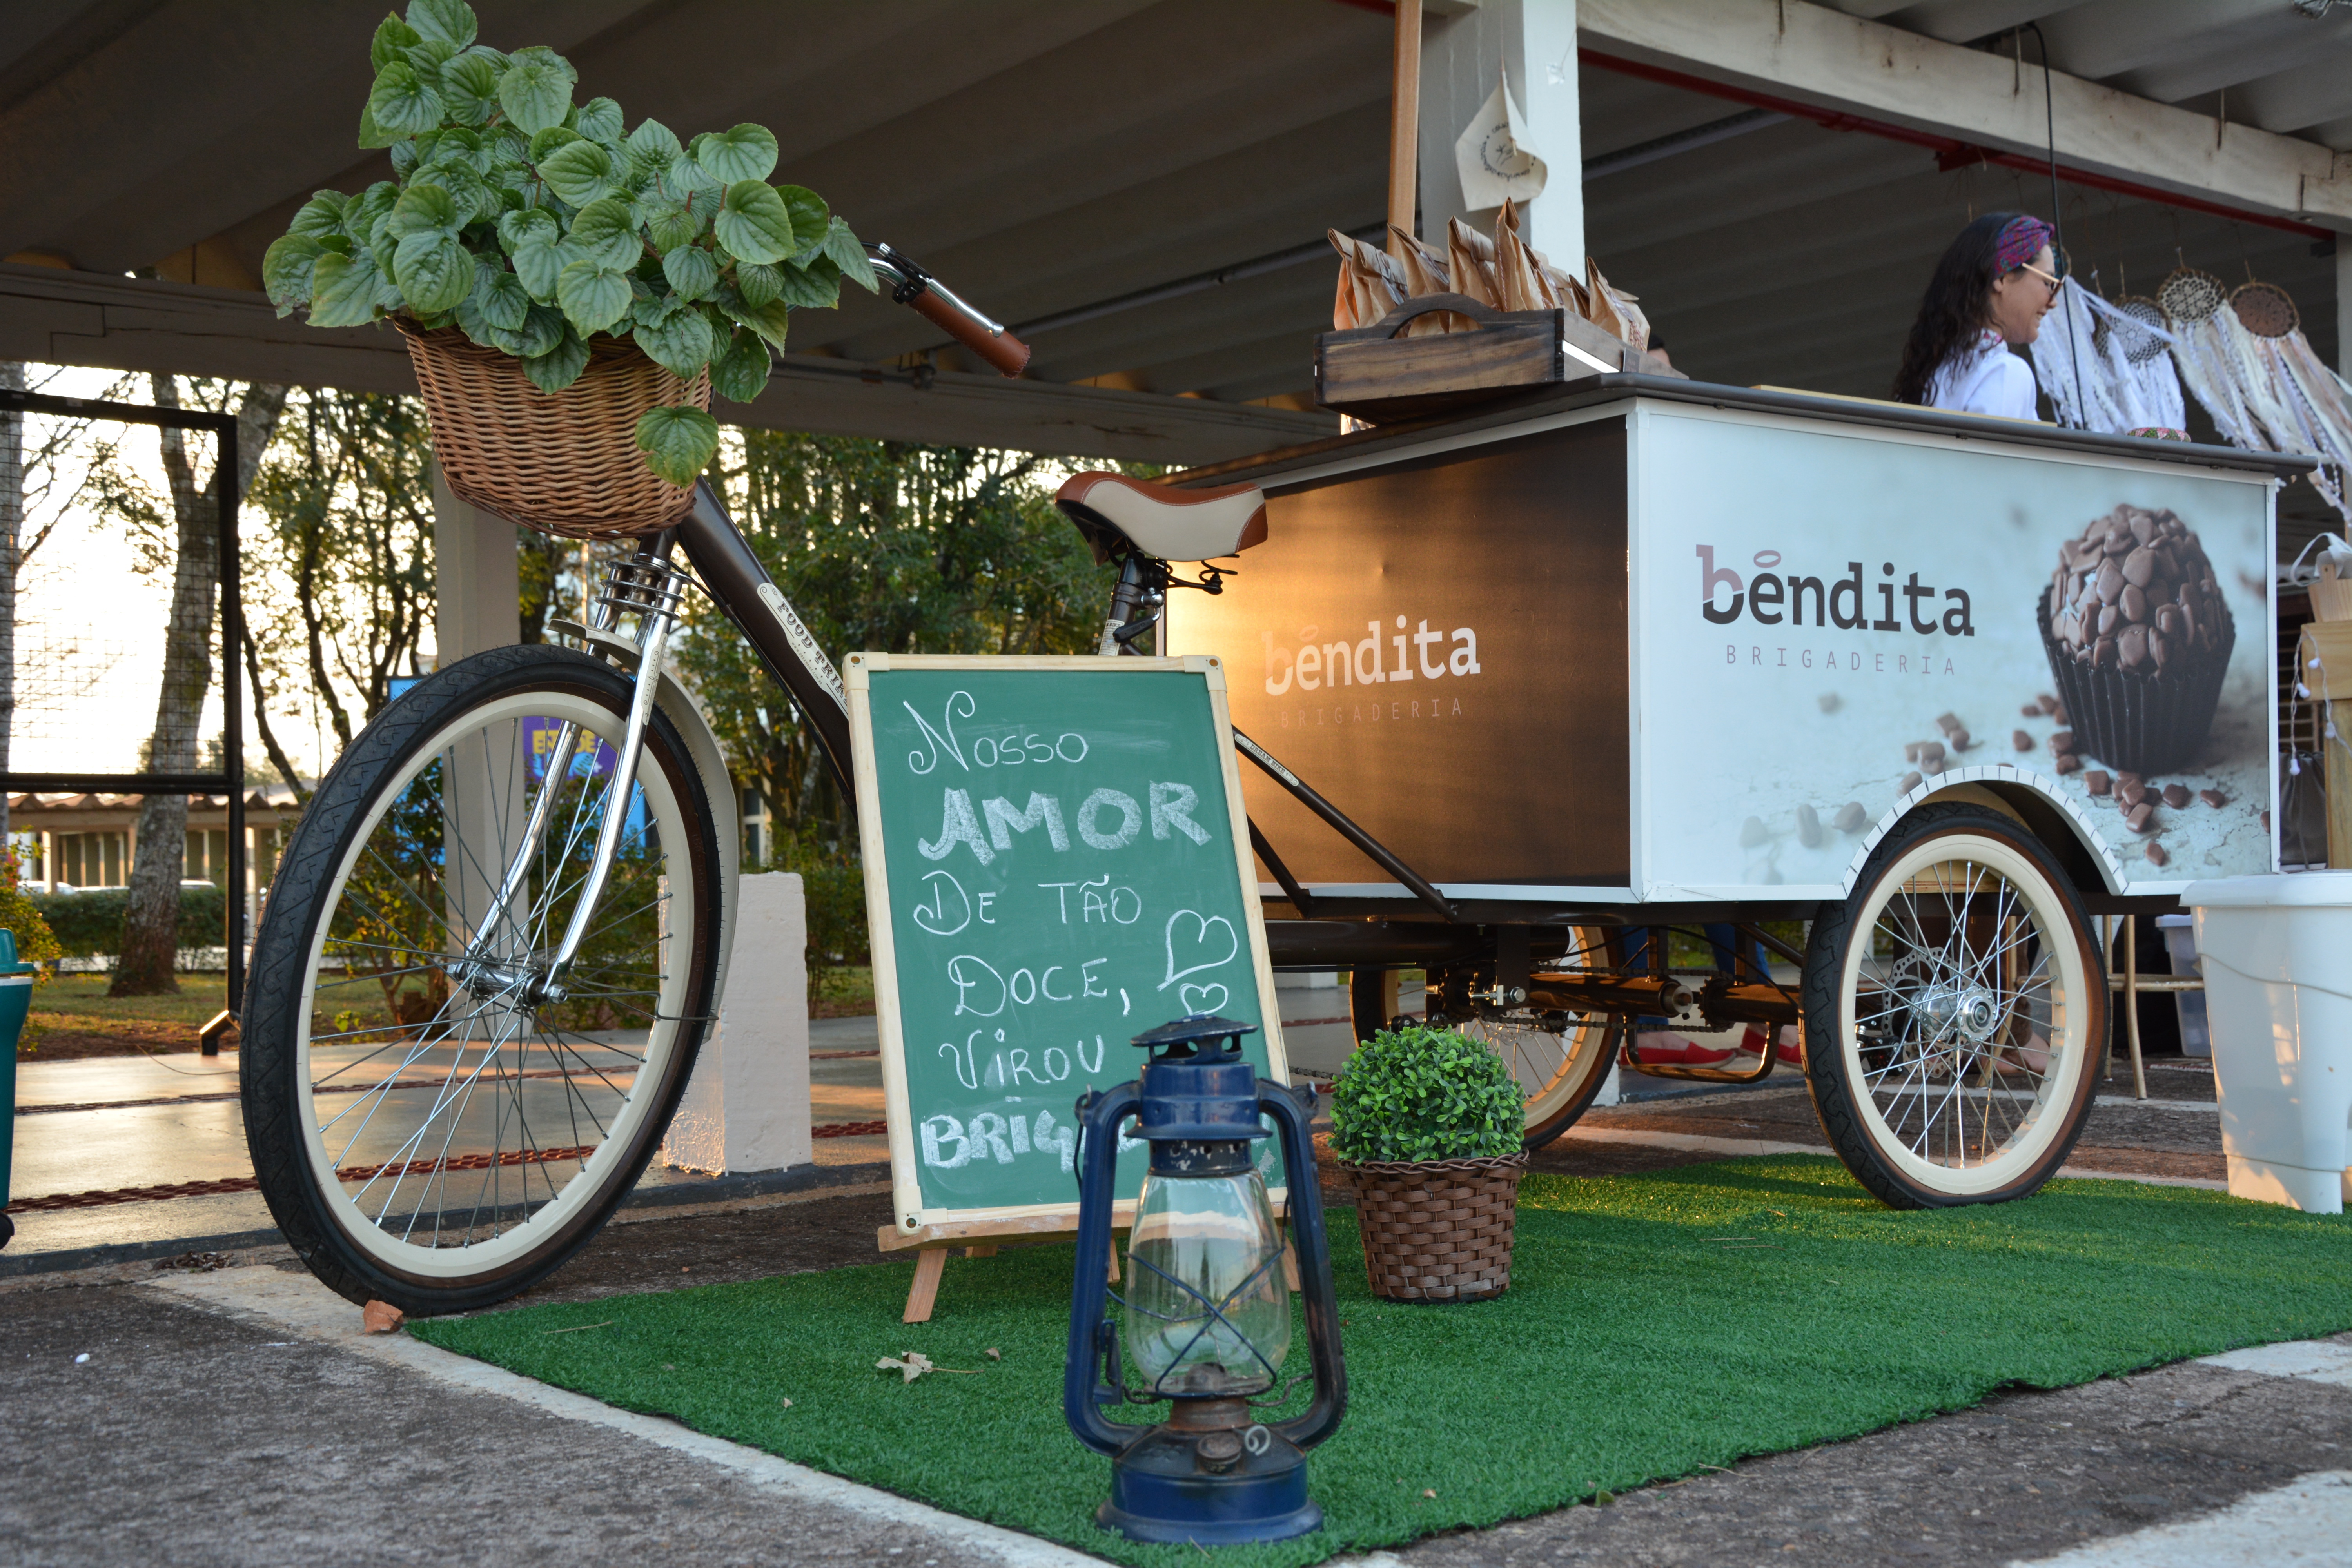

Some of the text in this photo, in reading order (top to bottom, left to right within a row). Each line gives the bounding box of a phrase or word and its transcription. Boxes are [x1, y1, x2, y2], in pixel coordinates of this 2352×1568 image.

[1696, 544, 1975, 637] bendita
[777, 601, 813, 648] FOOD
[1261, 615, 1481, 696] bendita
[1726, 644, 1954, 676] BRIGADERIA
[1281, 697, 1462, 729] BRIGADERIA
[1250, 744, 1286, 774] DREAM BIKE
[918, 780, 1213, 866] AMOR
[913, 870, 1142, 936] DE TÃO
[947, 954, 1131, 1017] DOCE,
